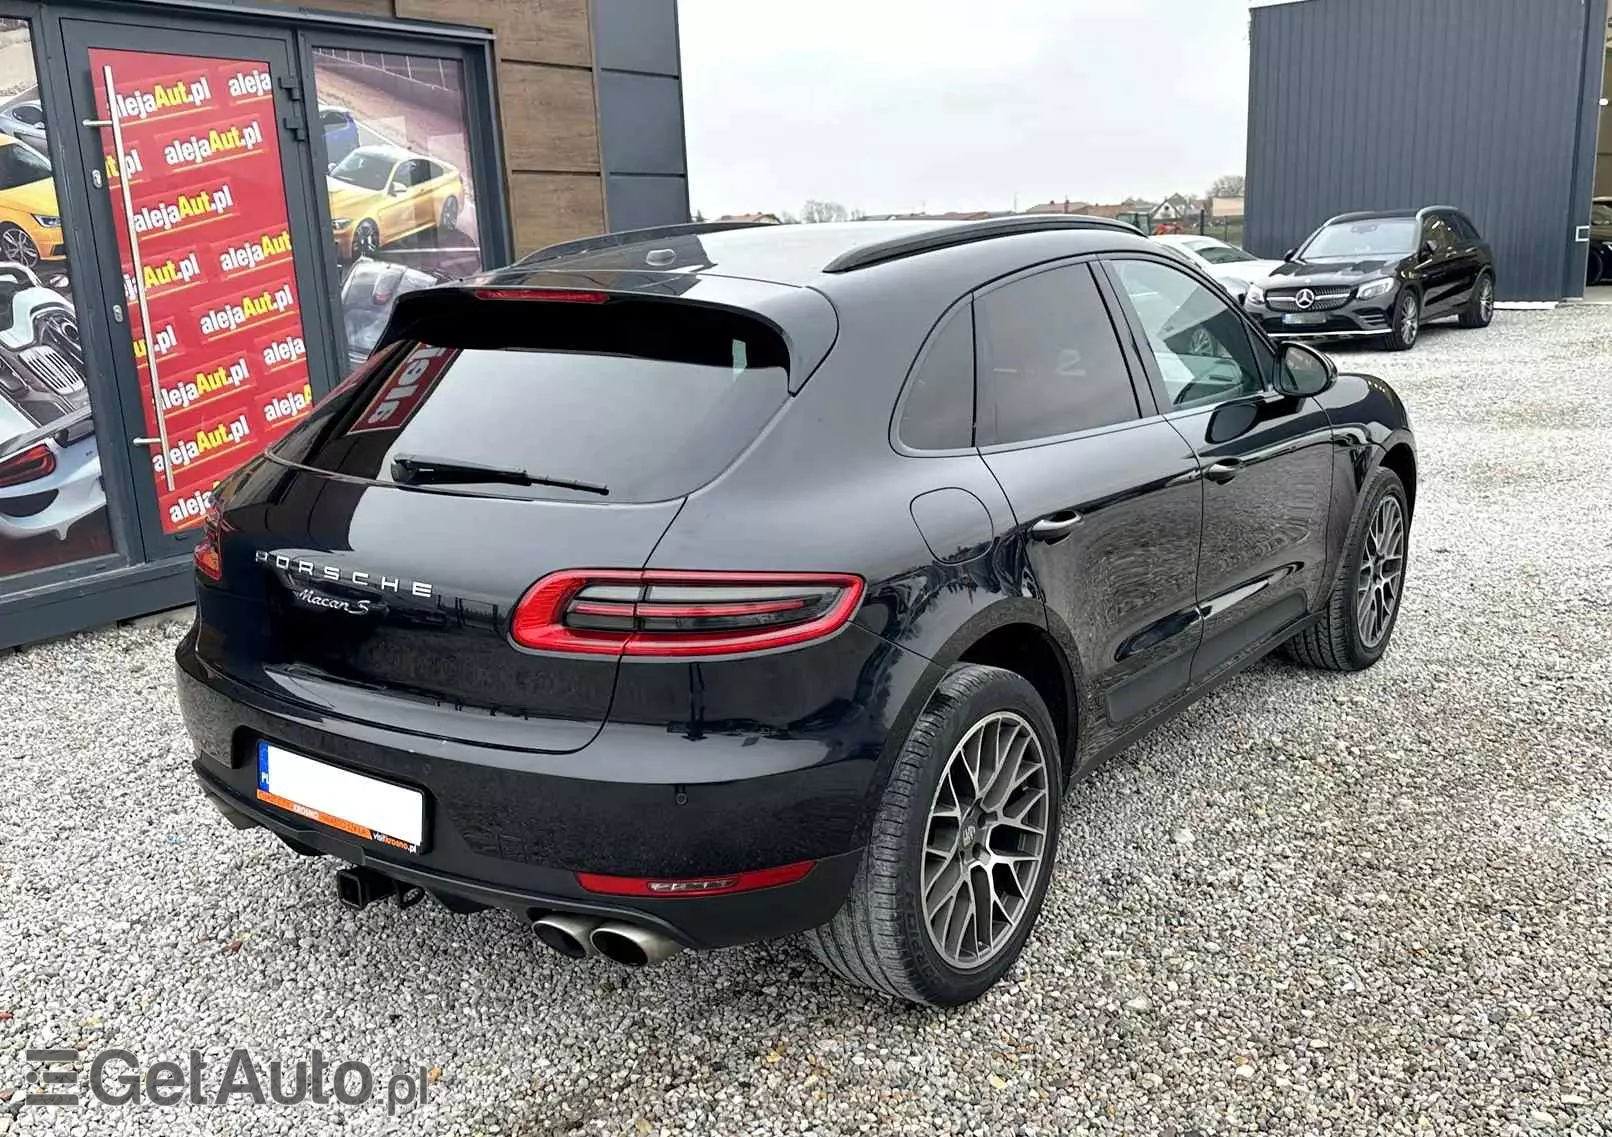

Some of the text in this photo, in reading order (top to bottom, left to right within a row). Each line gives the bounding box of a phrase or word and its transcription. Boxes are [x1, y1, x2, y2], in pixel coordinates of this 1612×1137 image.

[228, 70, 271, 97] aleja
[164, 121, 262, 165] alejaAut.pl
[133, 185, 233, 233] alejaAut.pl
[219, 230, 292, 272] alejaAut
[200, 285, 293, 335] alejaAut.pl
[263, 336, 306, 366] aleja
[152, 415, 249, 474] aejaAut.pl
[256, 551, 432, 598] PORSCHE
[293, 589, 371, 615] Macan S
